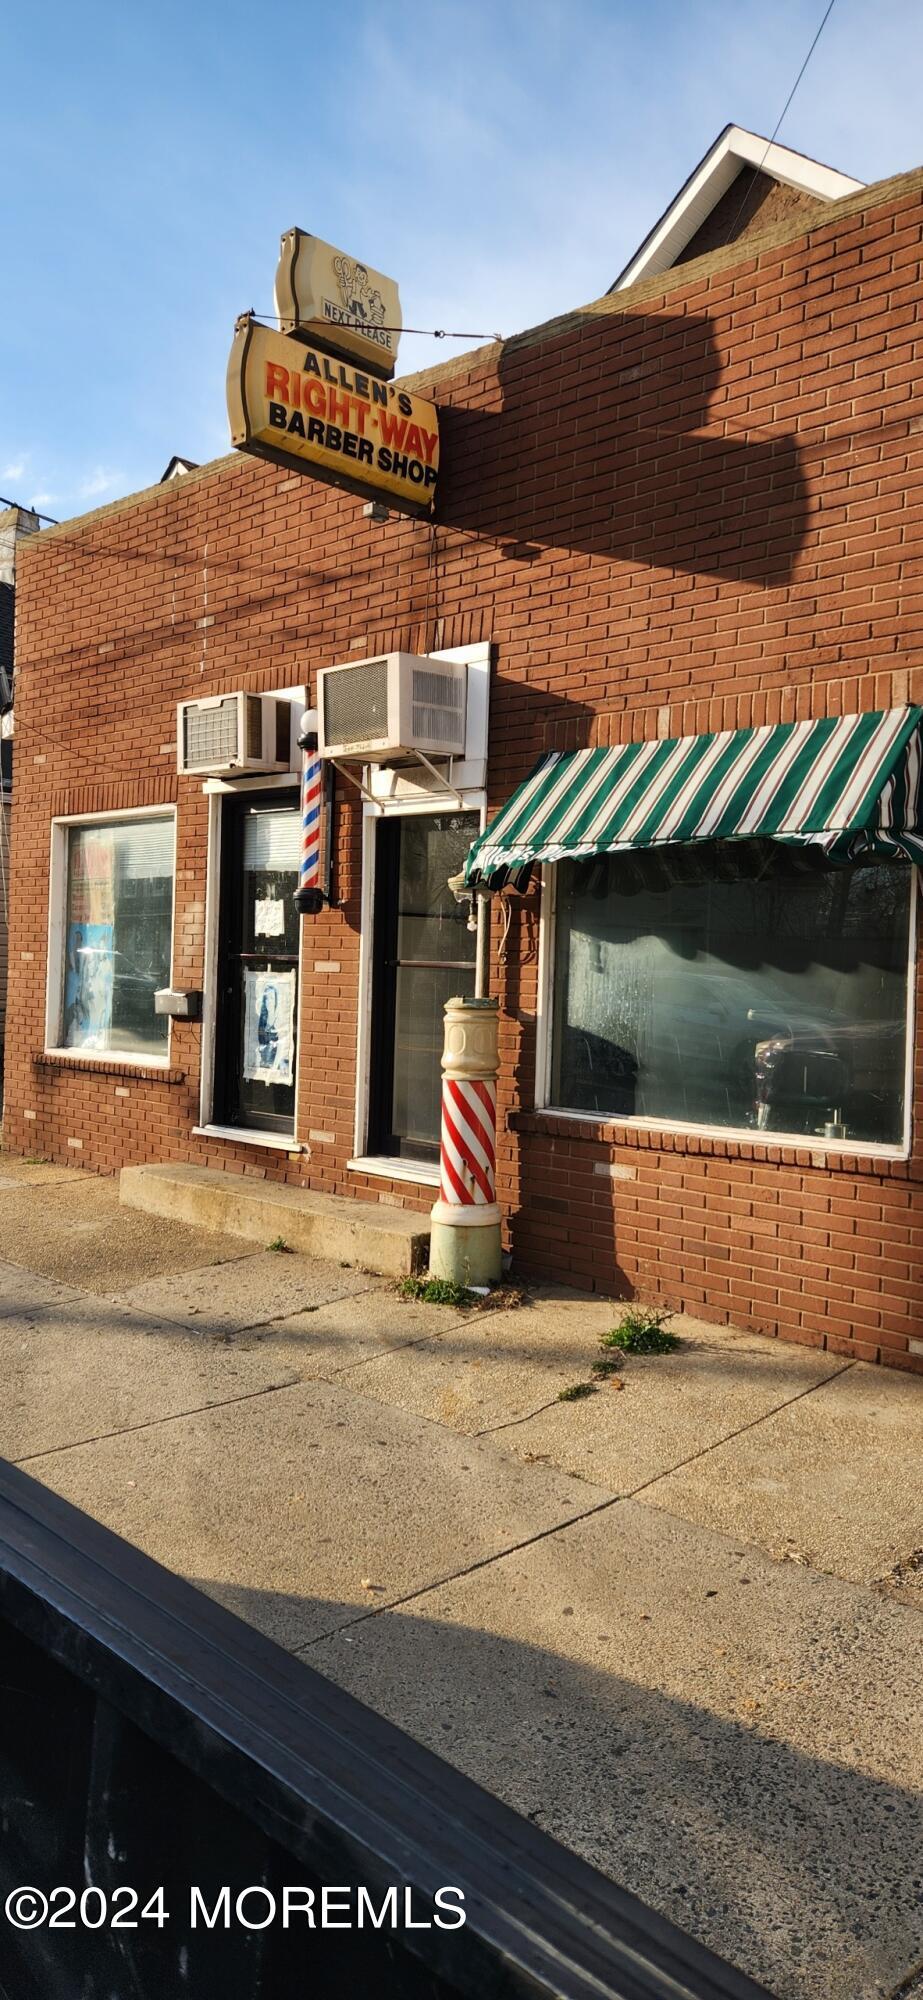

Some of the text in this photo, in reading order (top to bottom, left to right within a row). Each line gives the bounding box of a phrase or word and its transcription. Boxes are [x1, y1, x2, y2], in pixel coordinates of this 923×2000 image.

[324, 302, 392, 349] NEXT PLEASE
[303, 351, 412, 416] ALLEN'S
[269, 402, 438, 488] BARBER SHOP
